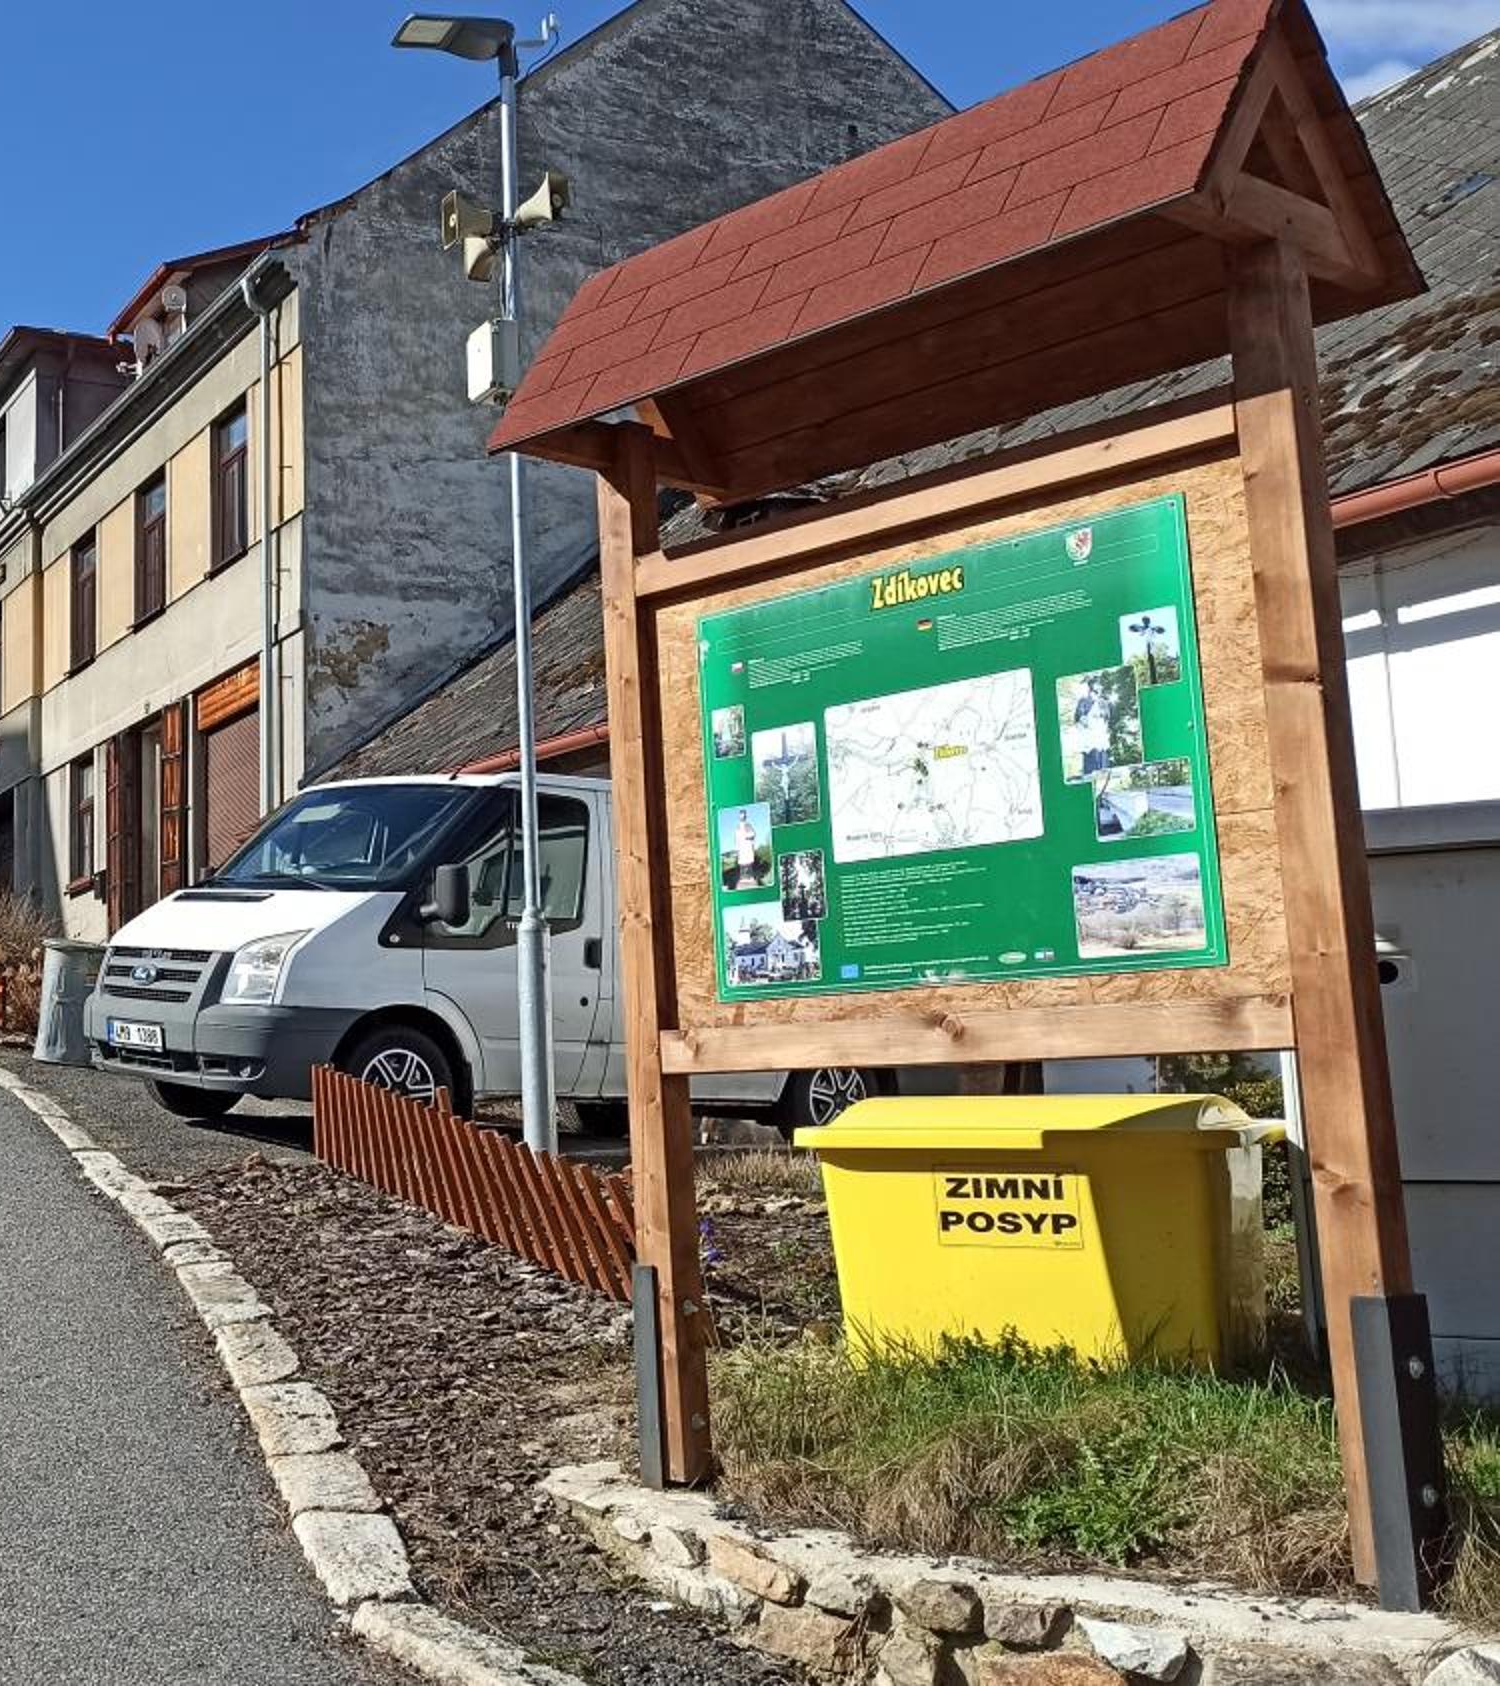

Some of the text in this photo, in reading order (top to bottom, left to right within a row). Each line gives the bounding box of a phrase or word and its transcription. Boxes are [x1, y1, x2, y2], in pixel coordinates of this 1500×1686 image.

[871, 566, 964, 611] Zdíkovec
[945, 1172, 1064, 1201] ZIMNÍ
[940, 1210, 1077, 1235] POSYP
